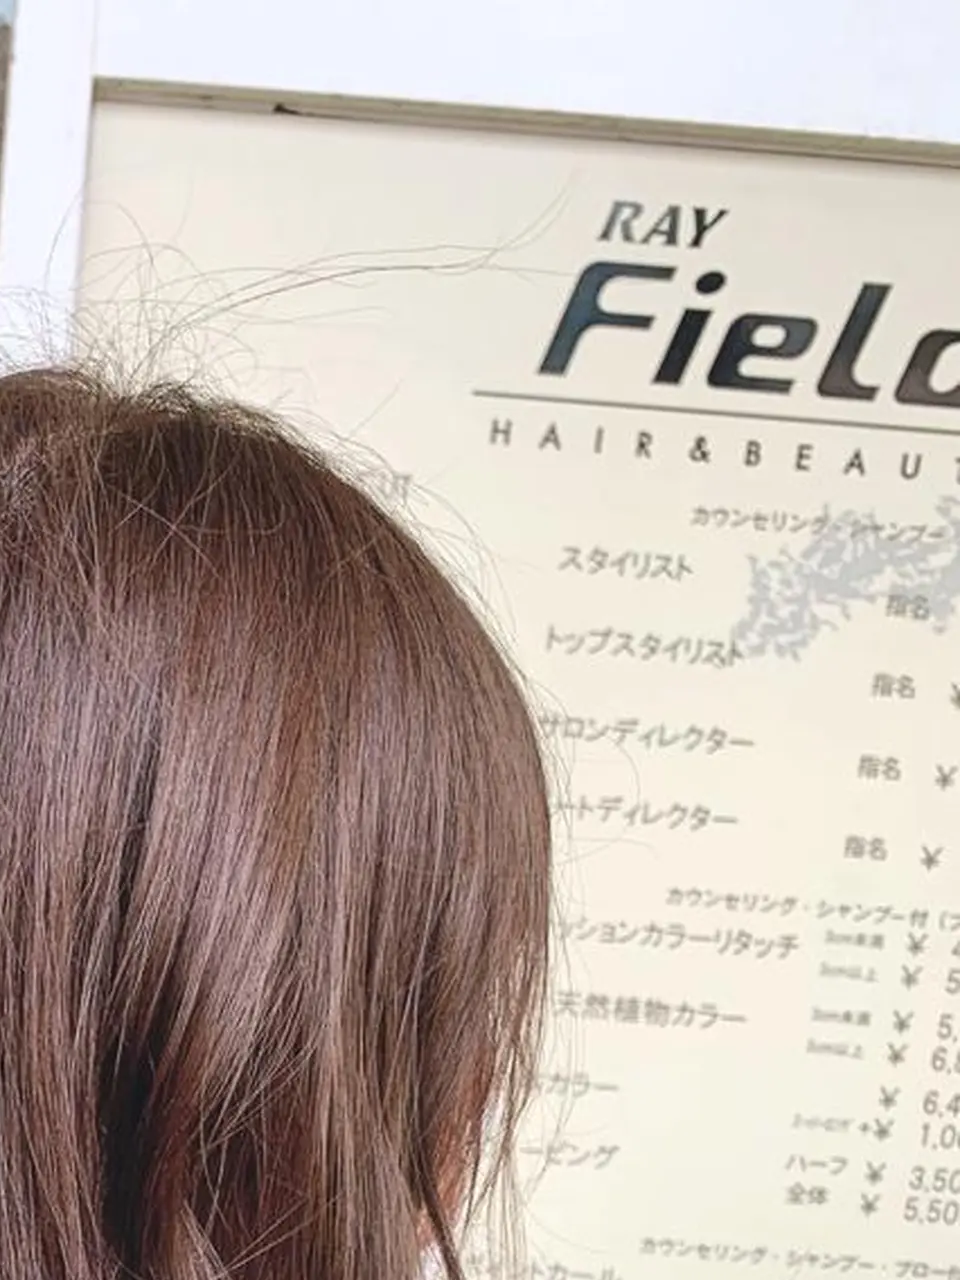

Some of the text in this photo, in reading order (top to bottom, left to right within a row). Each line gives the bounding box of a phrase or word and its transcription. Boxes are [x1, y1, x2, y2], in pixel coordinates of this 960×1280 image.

[598, 200, 728, 248] RAY
[488, 418, 960, 485] HAIR&BEAU
[557, 546, 693, 581] スタイリスト
[546, 623, 745, 668] トップスタイリスト
[872, 673, 916, 699] 指名
[540, 714, 755, 755] サロンディレクター
[857, 753, 901, 781] 指名
[844, 835, 888, 861] 指名
[554, 991, 748, 1028] 天然植物カラー
[785, 1154, 848, 1176] ハーフ
